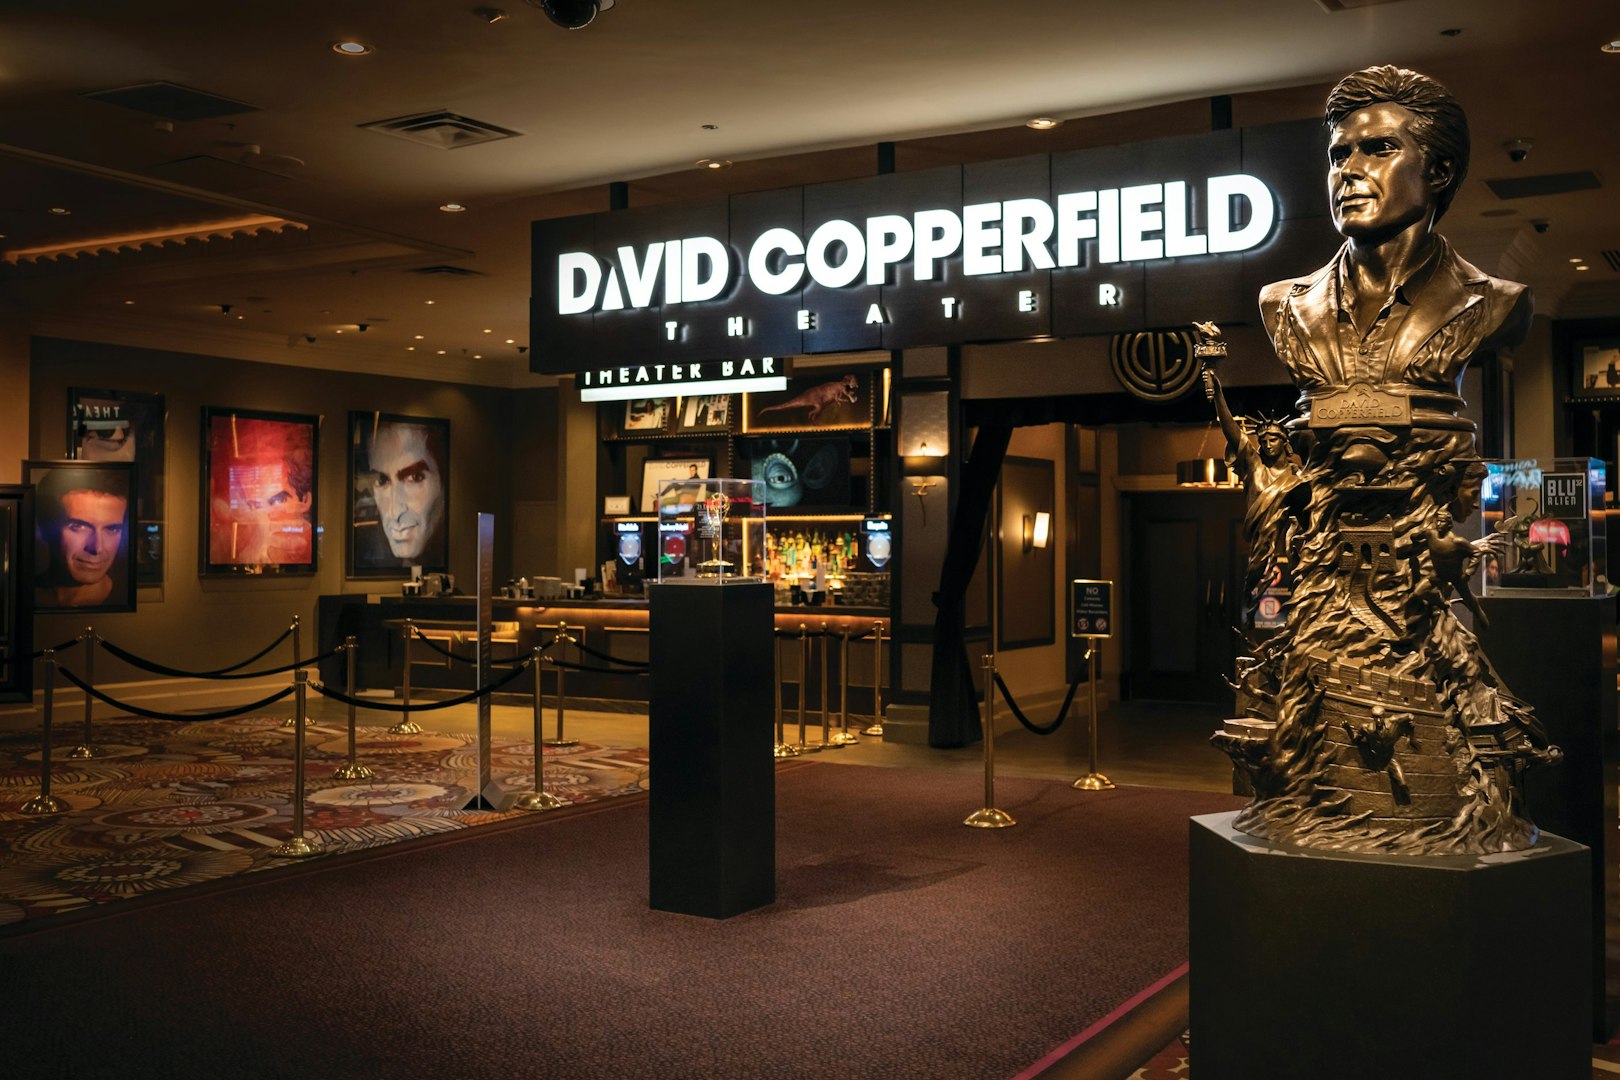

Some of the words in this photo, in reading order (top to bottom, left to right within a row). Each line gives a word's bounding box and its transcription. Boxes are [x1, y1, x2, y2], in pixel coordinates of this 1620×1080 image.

[558, 236, 729, 315] DAVID
[747, 173, 1274, 296] COPPERFIELD
[665, 283, 1117, 342] THEATER
[722, 356, 775, 377] BAR
[1318, 405, 1402, 419] COPPERFIELD
[1340, 399, 1379, 408] DAVID
[1086, 587, 1098, 595] NO
